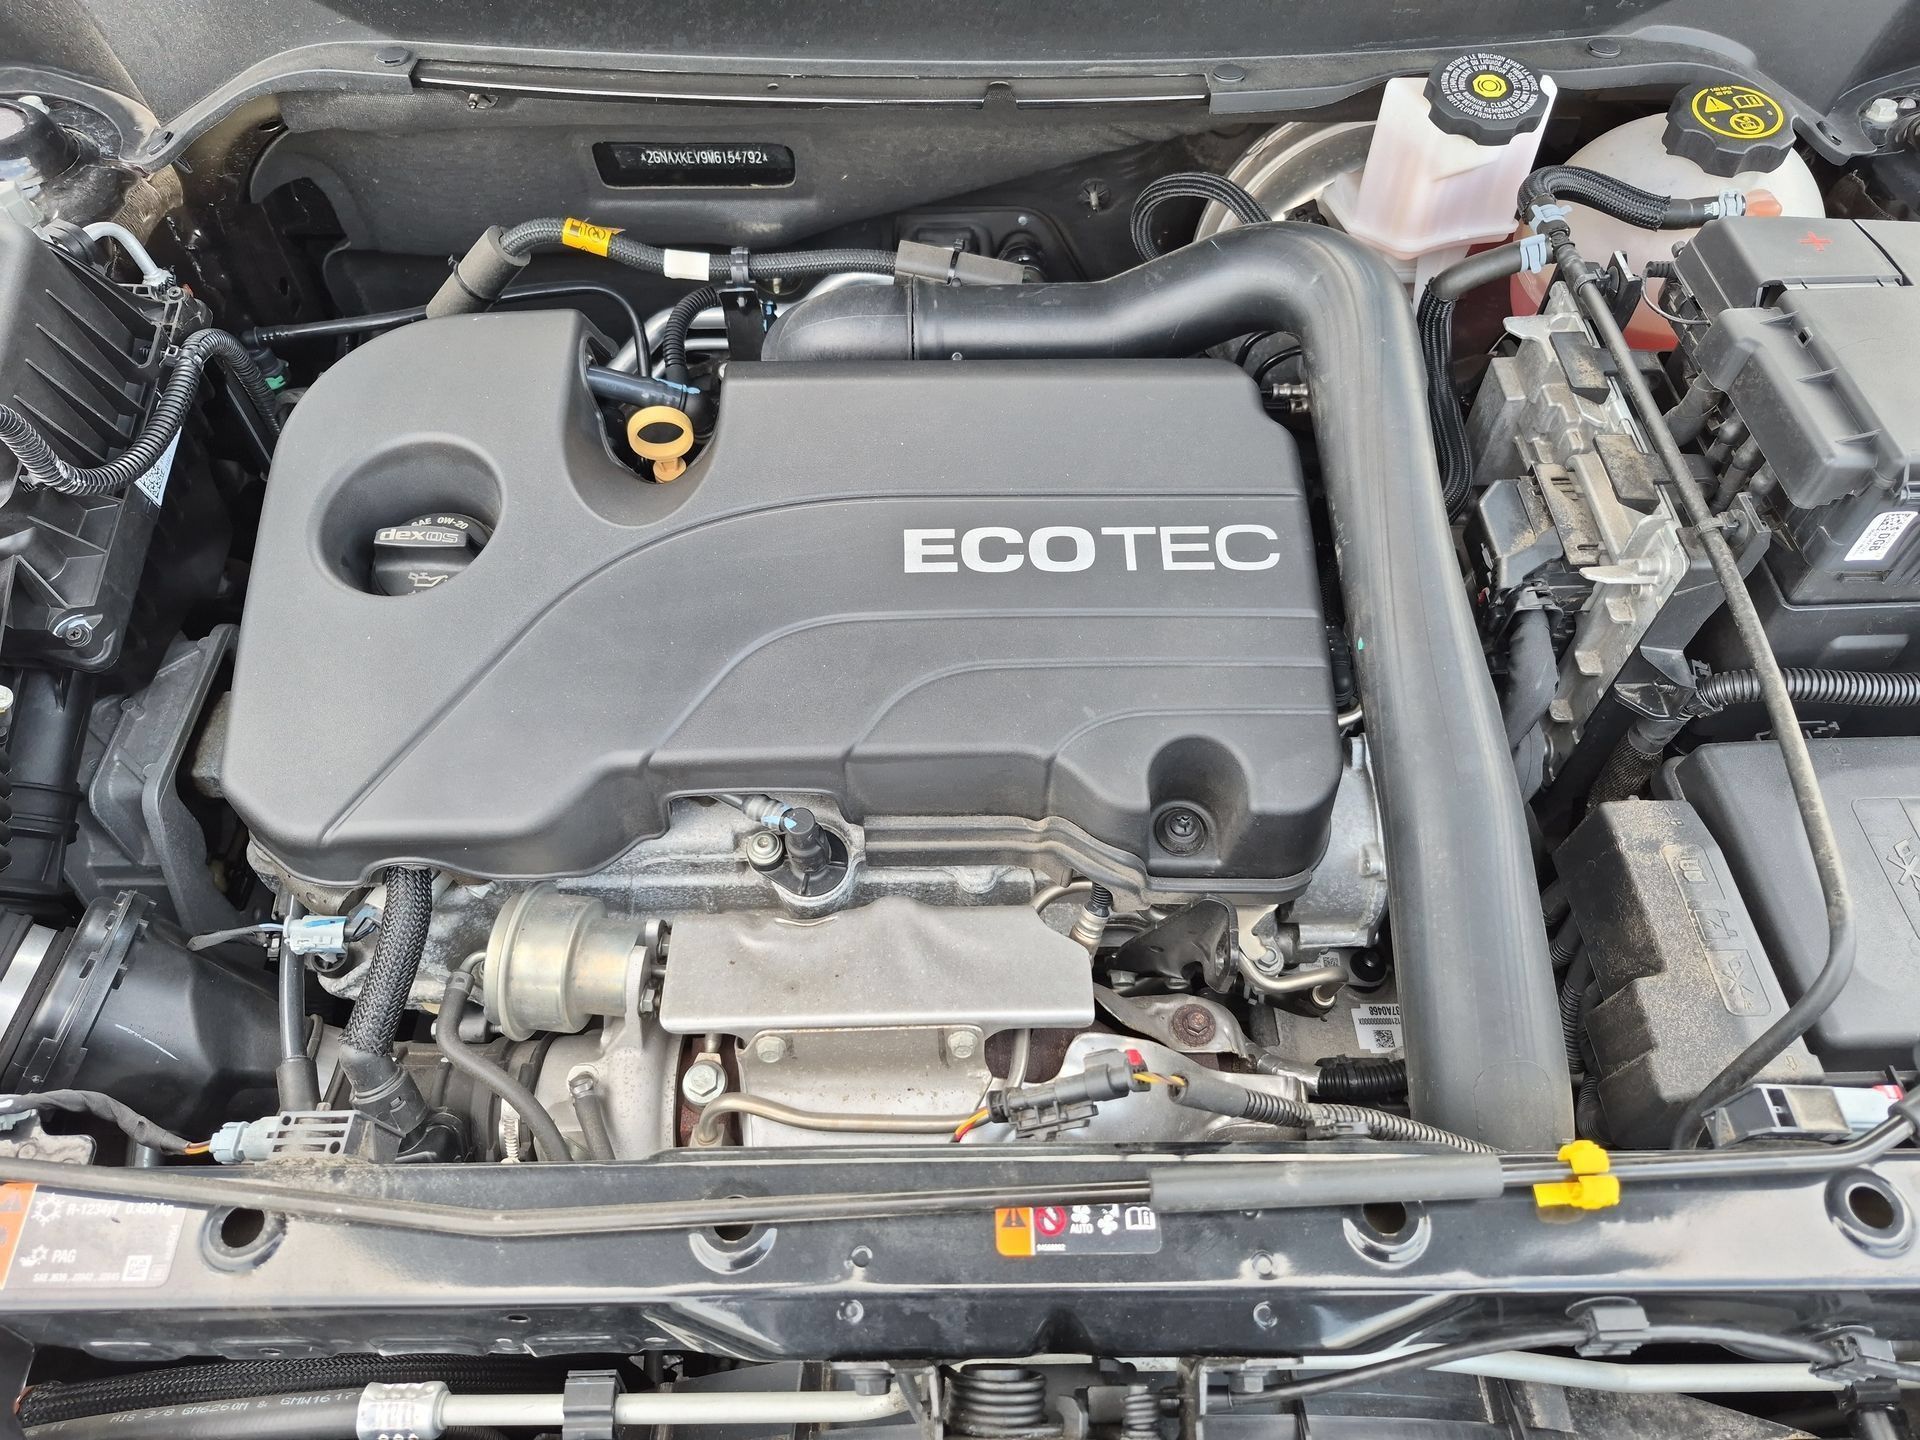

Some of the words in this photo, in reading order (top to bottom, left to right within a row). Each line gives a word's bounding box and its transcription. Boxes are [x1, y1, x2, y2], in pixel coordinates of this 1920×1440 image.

[1478, 53, 1506, 61] BOUCHON
[1506, 58, 1524, 69] AVANT
[437, 516, 469, 530] 0W-20
[380, 528, 459, 543] dexos
[904, 524, 1280, 573] ECOTEC
[1070, 1224, 1094, 1234] AUTO
[51, 1249, 77, 1263] PAG
